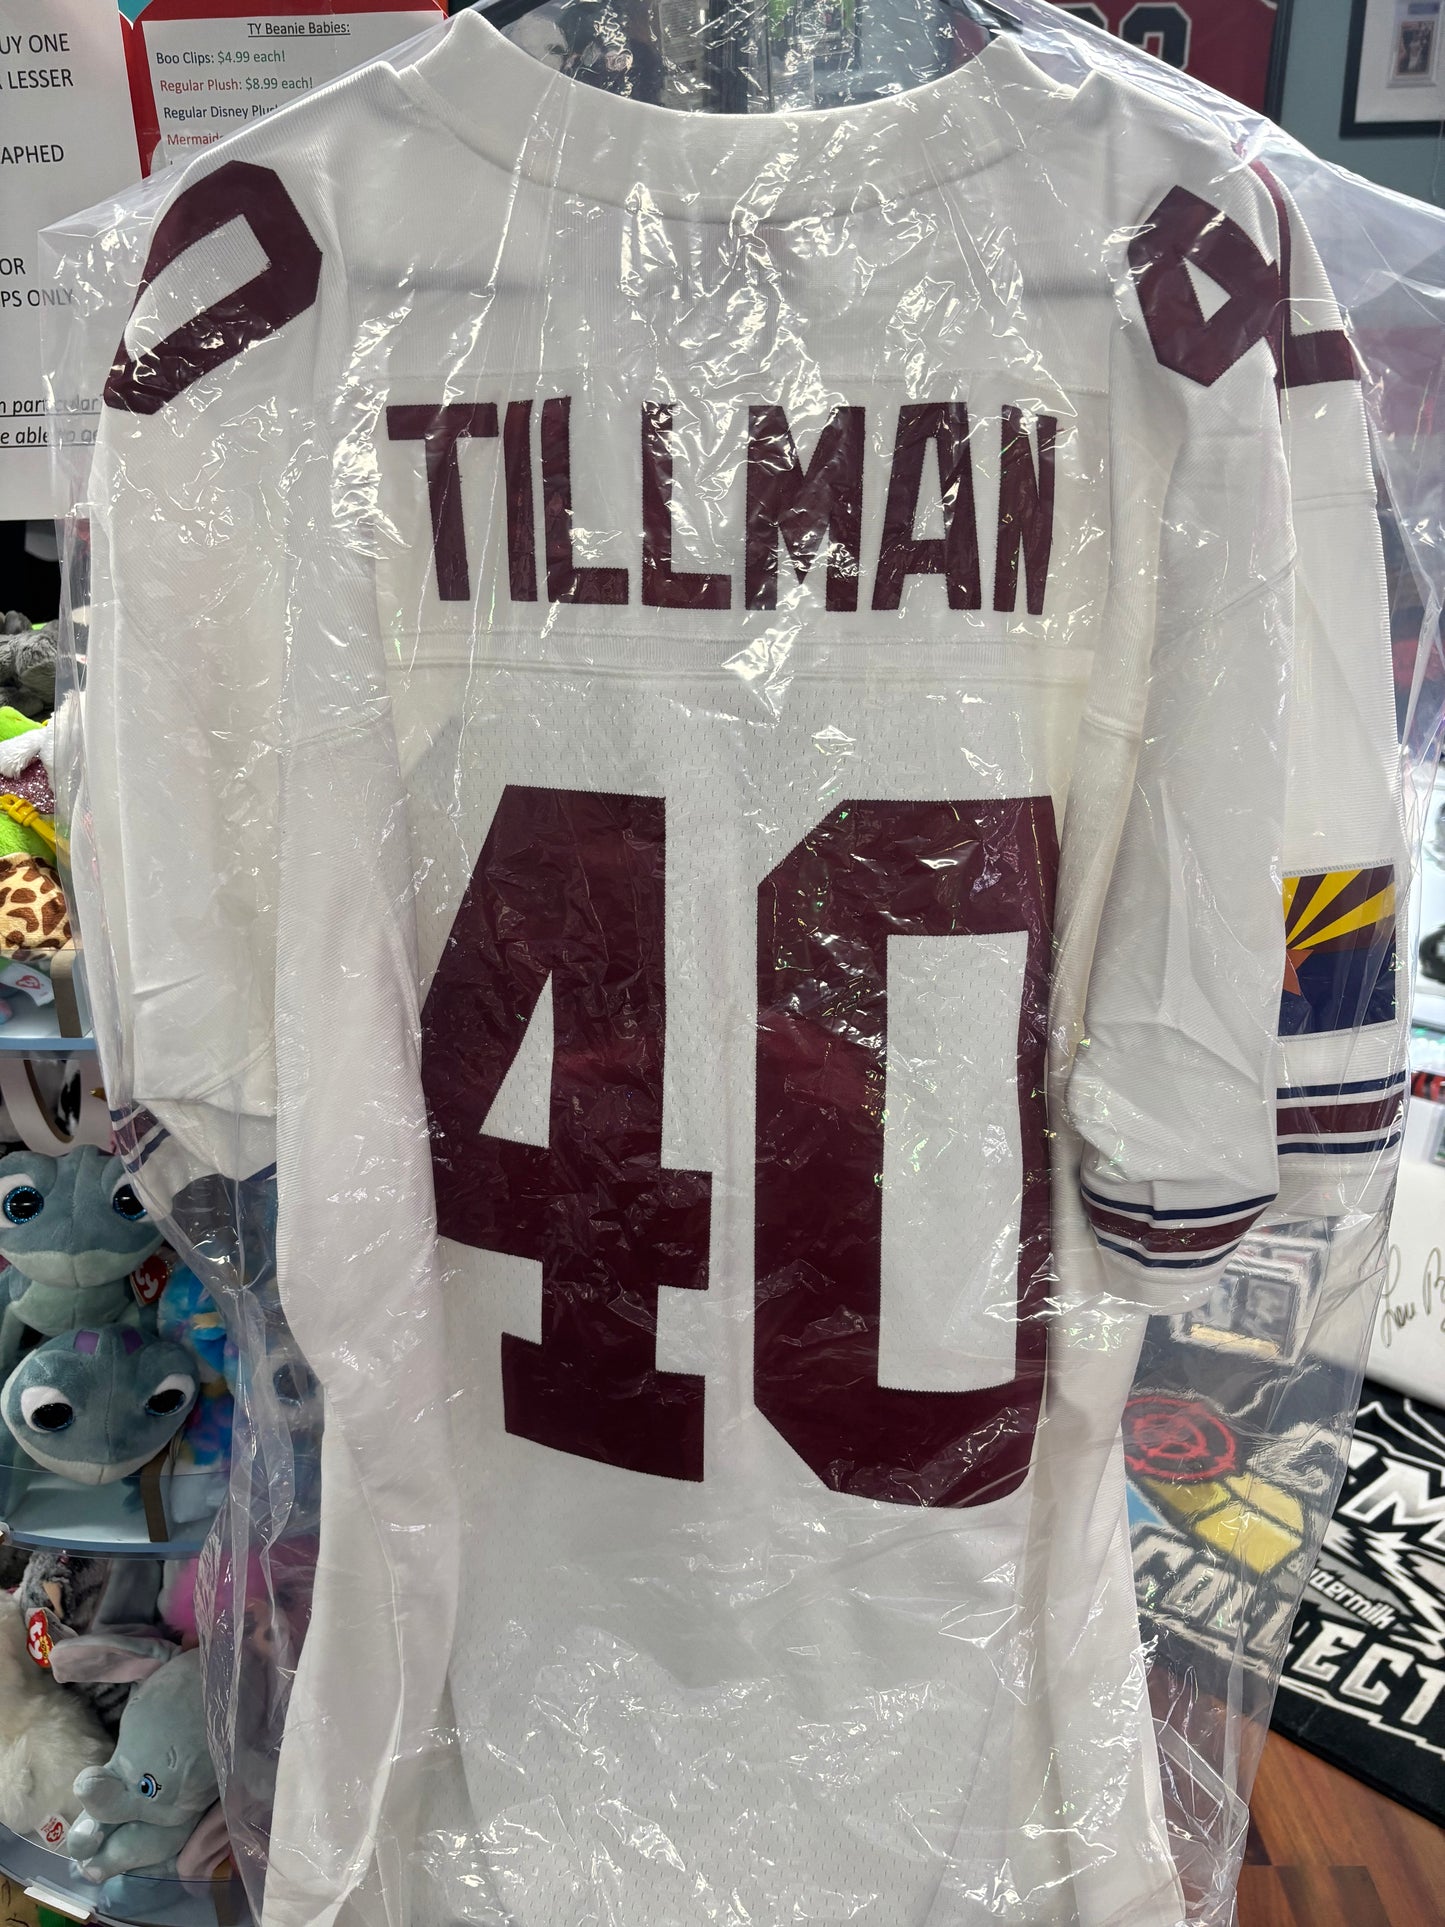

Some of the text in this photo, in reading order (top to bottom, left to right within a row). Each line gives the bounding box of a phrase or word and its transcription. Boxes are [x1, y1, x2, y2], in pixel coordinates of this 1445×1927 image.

[247, 20, 350, 35] TY Beanie Babies:
[28, 32, 70, 53] ONE
[156, 50, 286, 67] Boo Clips: $4.99 each!
[7, 68, 74, 89] LESSER
[160, 76, 313, 94] Regular Plush: $8.99 each!
[163, 103, 278, 121] Regular Disney Plu
[0, 144, 65, 165] APHED
[0, 257, 26, 275] OR
[0, 288, 73, 308] PS ONLY
[386, 395, 1057, 615] TILLMAN
[420, 784, 1060, 1509] 40
